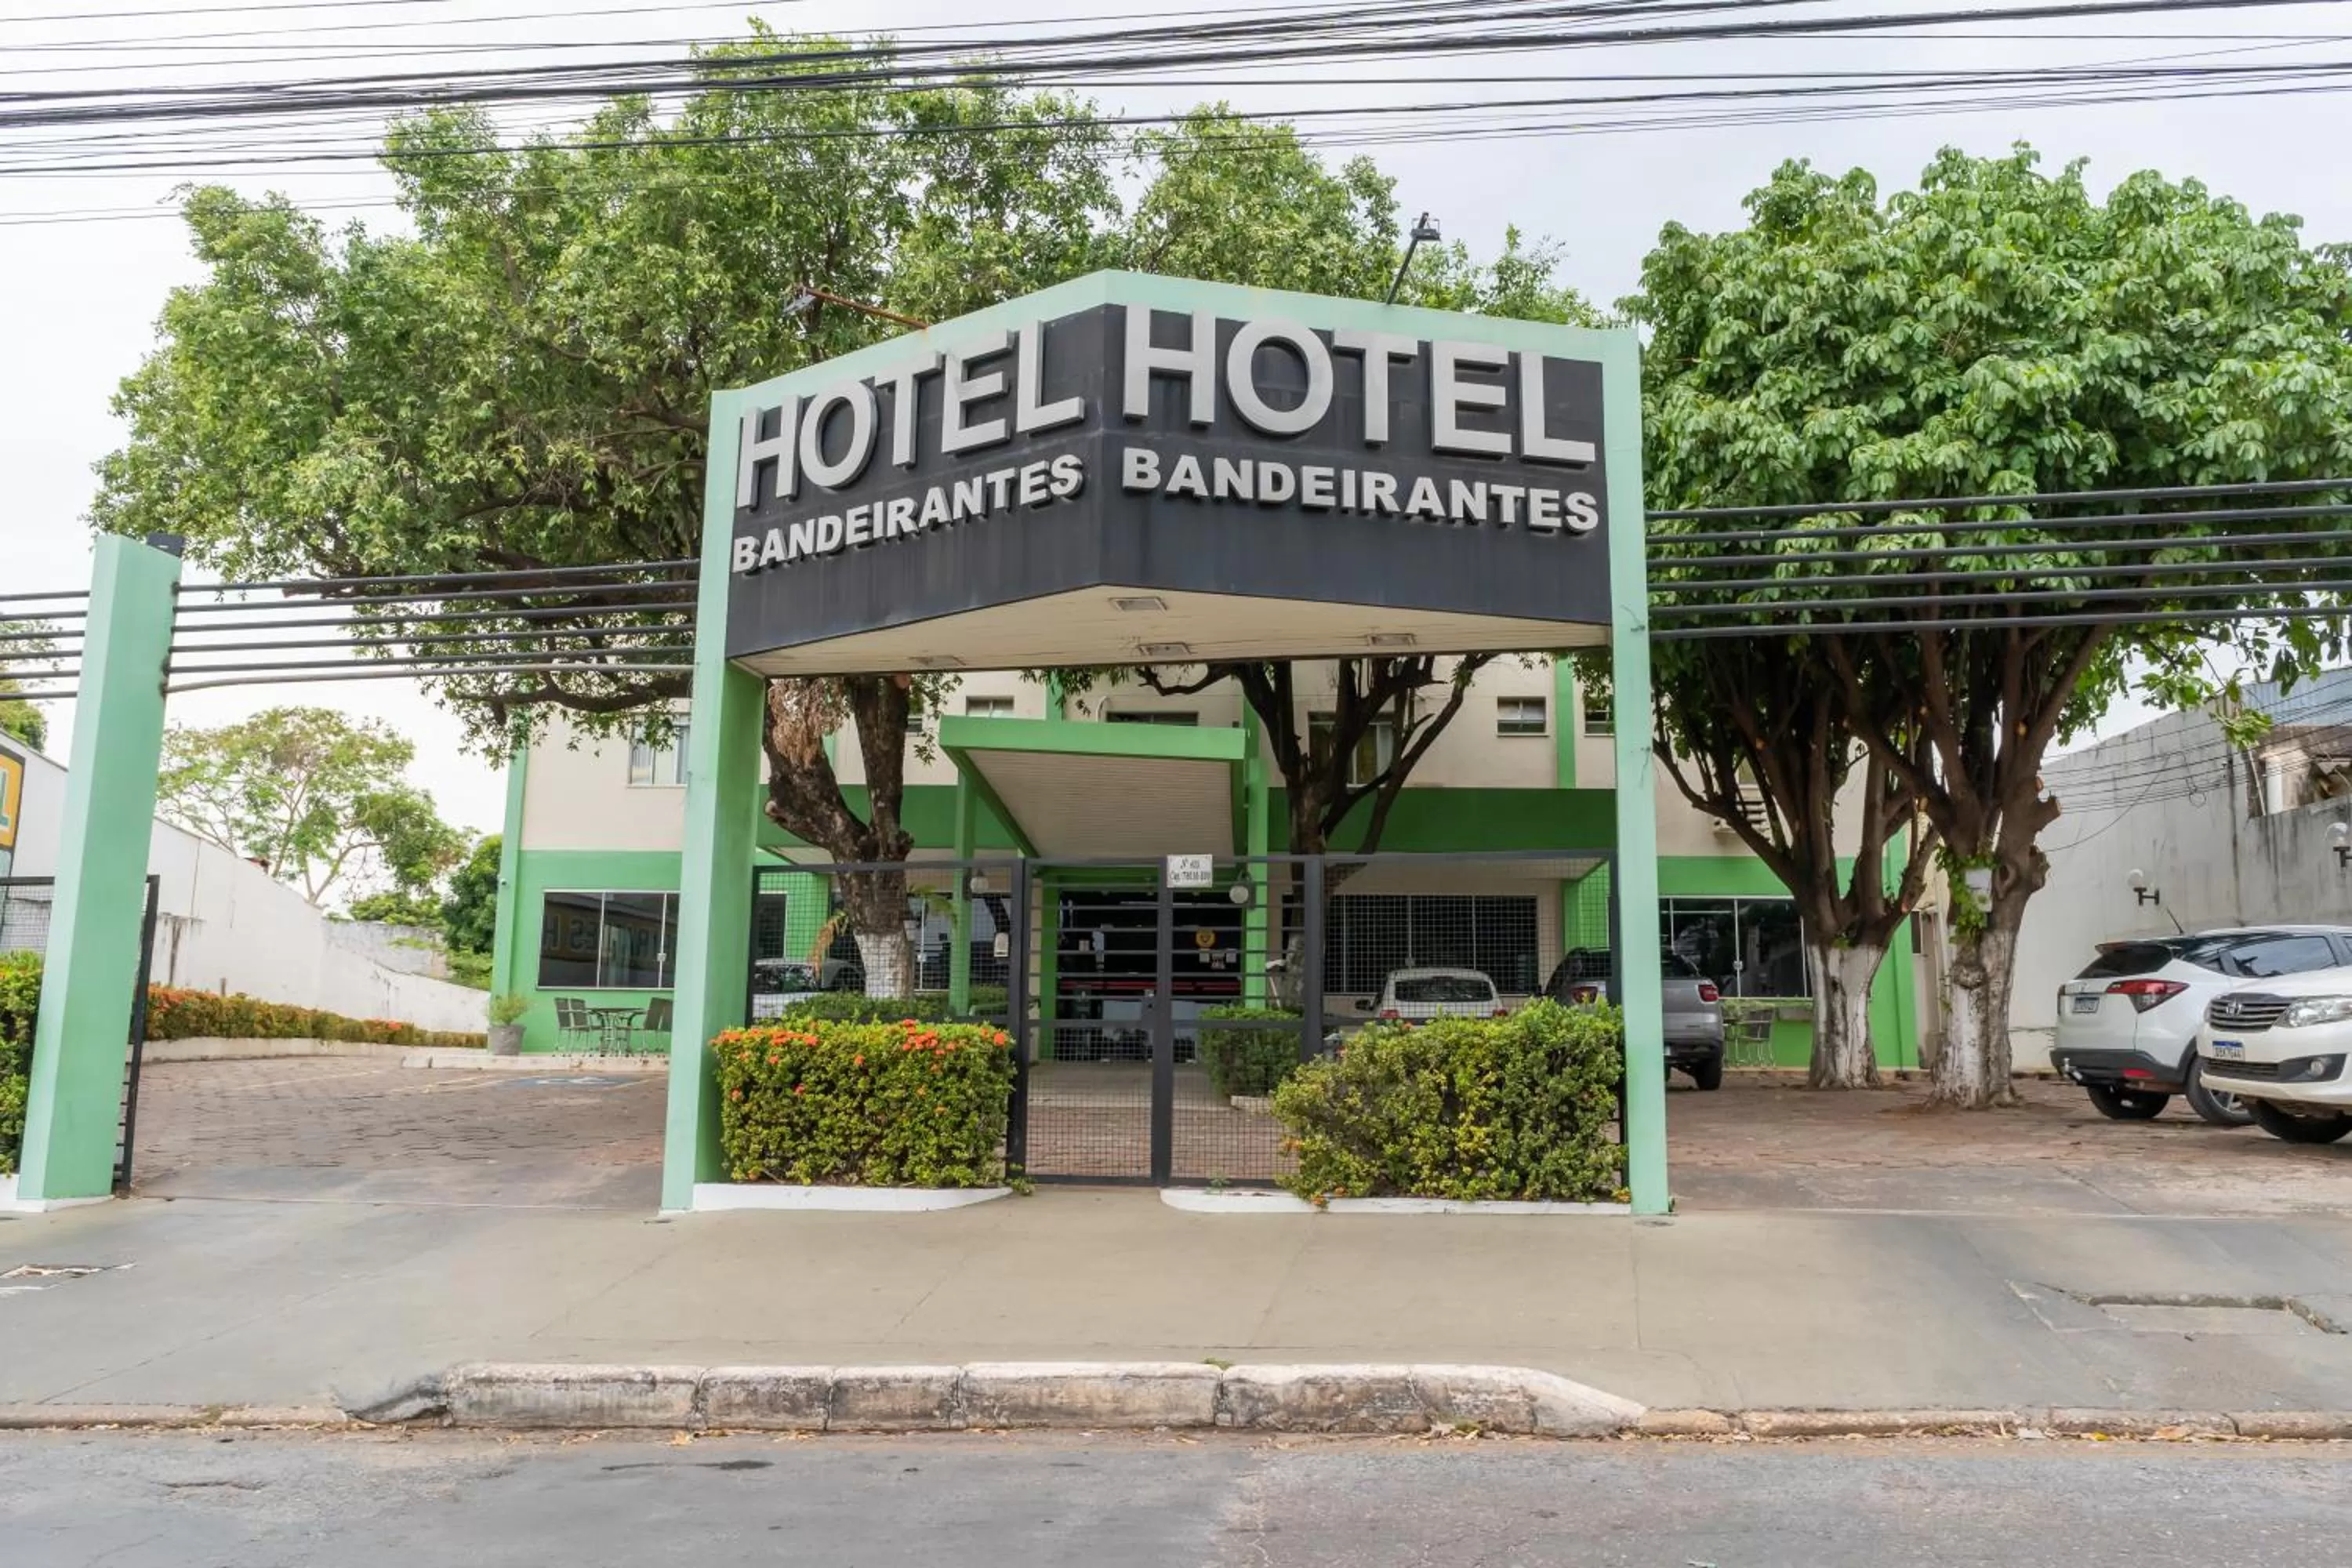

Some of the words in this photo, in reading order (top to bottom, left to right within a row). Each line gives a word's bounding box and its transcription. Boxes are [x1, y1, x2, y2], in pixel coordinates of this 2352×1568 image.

[736, 320, 1084, 509] HOTEL
[1122, 302, 1595, 464] HOTEL
[731, 453, 1084, 574] BANDEIRANTES
[1121, 446, 1599, 532] BANDEIRANTES
